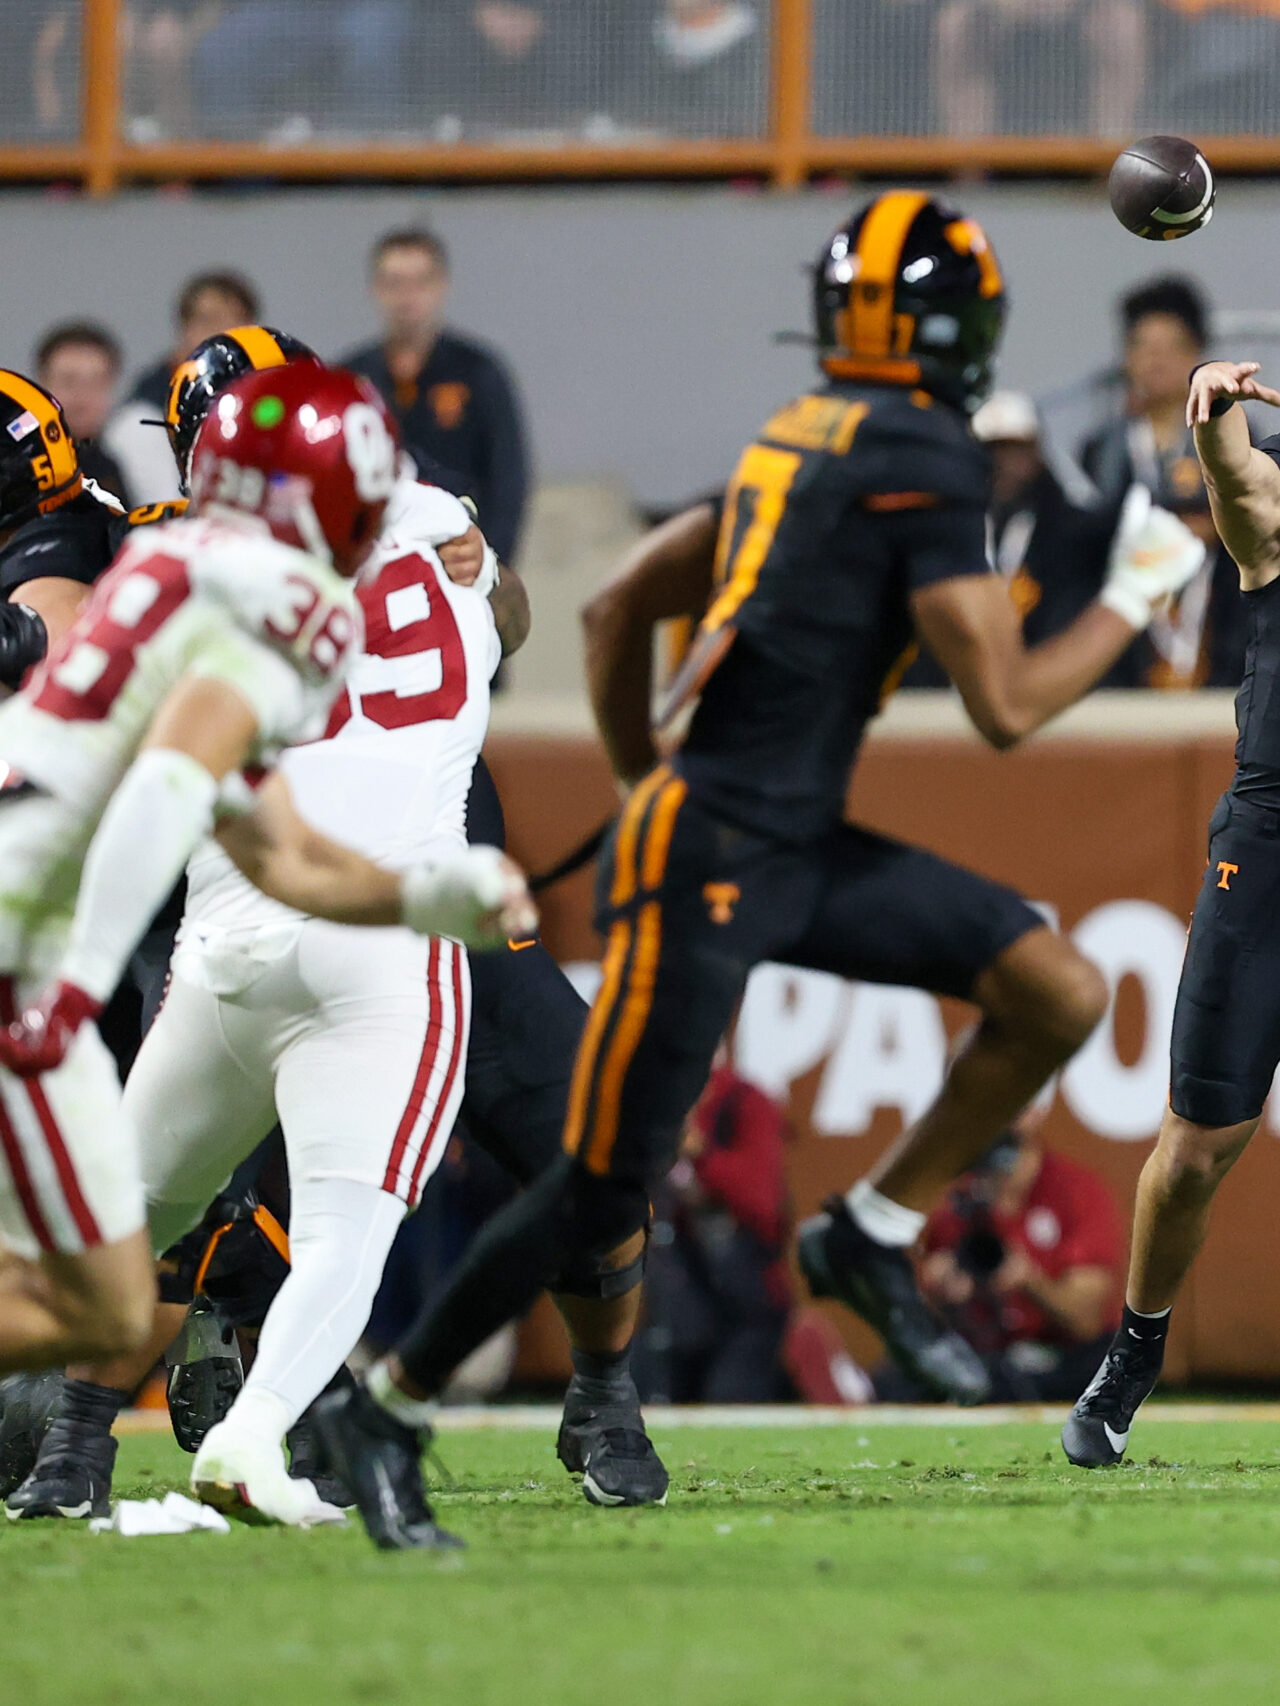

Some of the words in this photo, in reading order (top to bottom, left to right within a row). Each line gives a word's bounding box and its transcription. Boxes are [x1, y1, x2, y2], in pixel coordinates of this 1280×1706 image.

[30, 453, 55, 491] 5
[264, 574, 355, 678] 38
[1216, 861, 1238, 890] T
